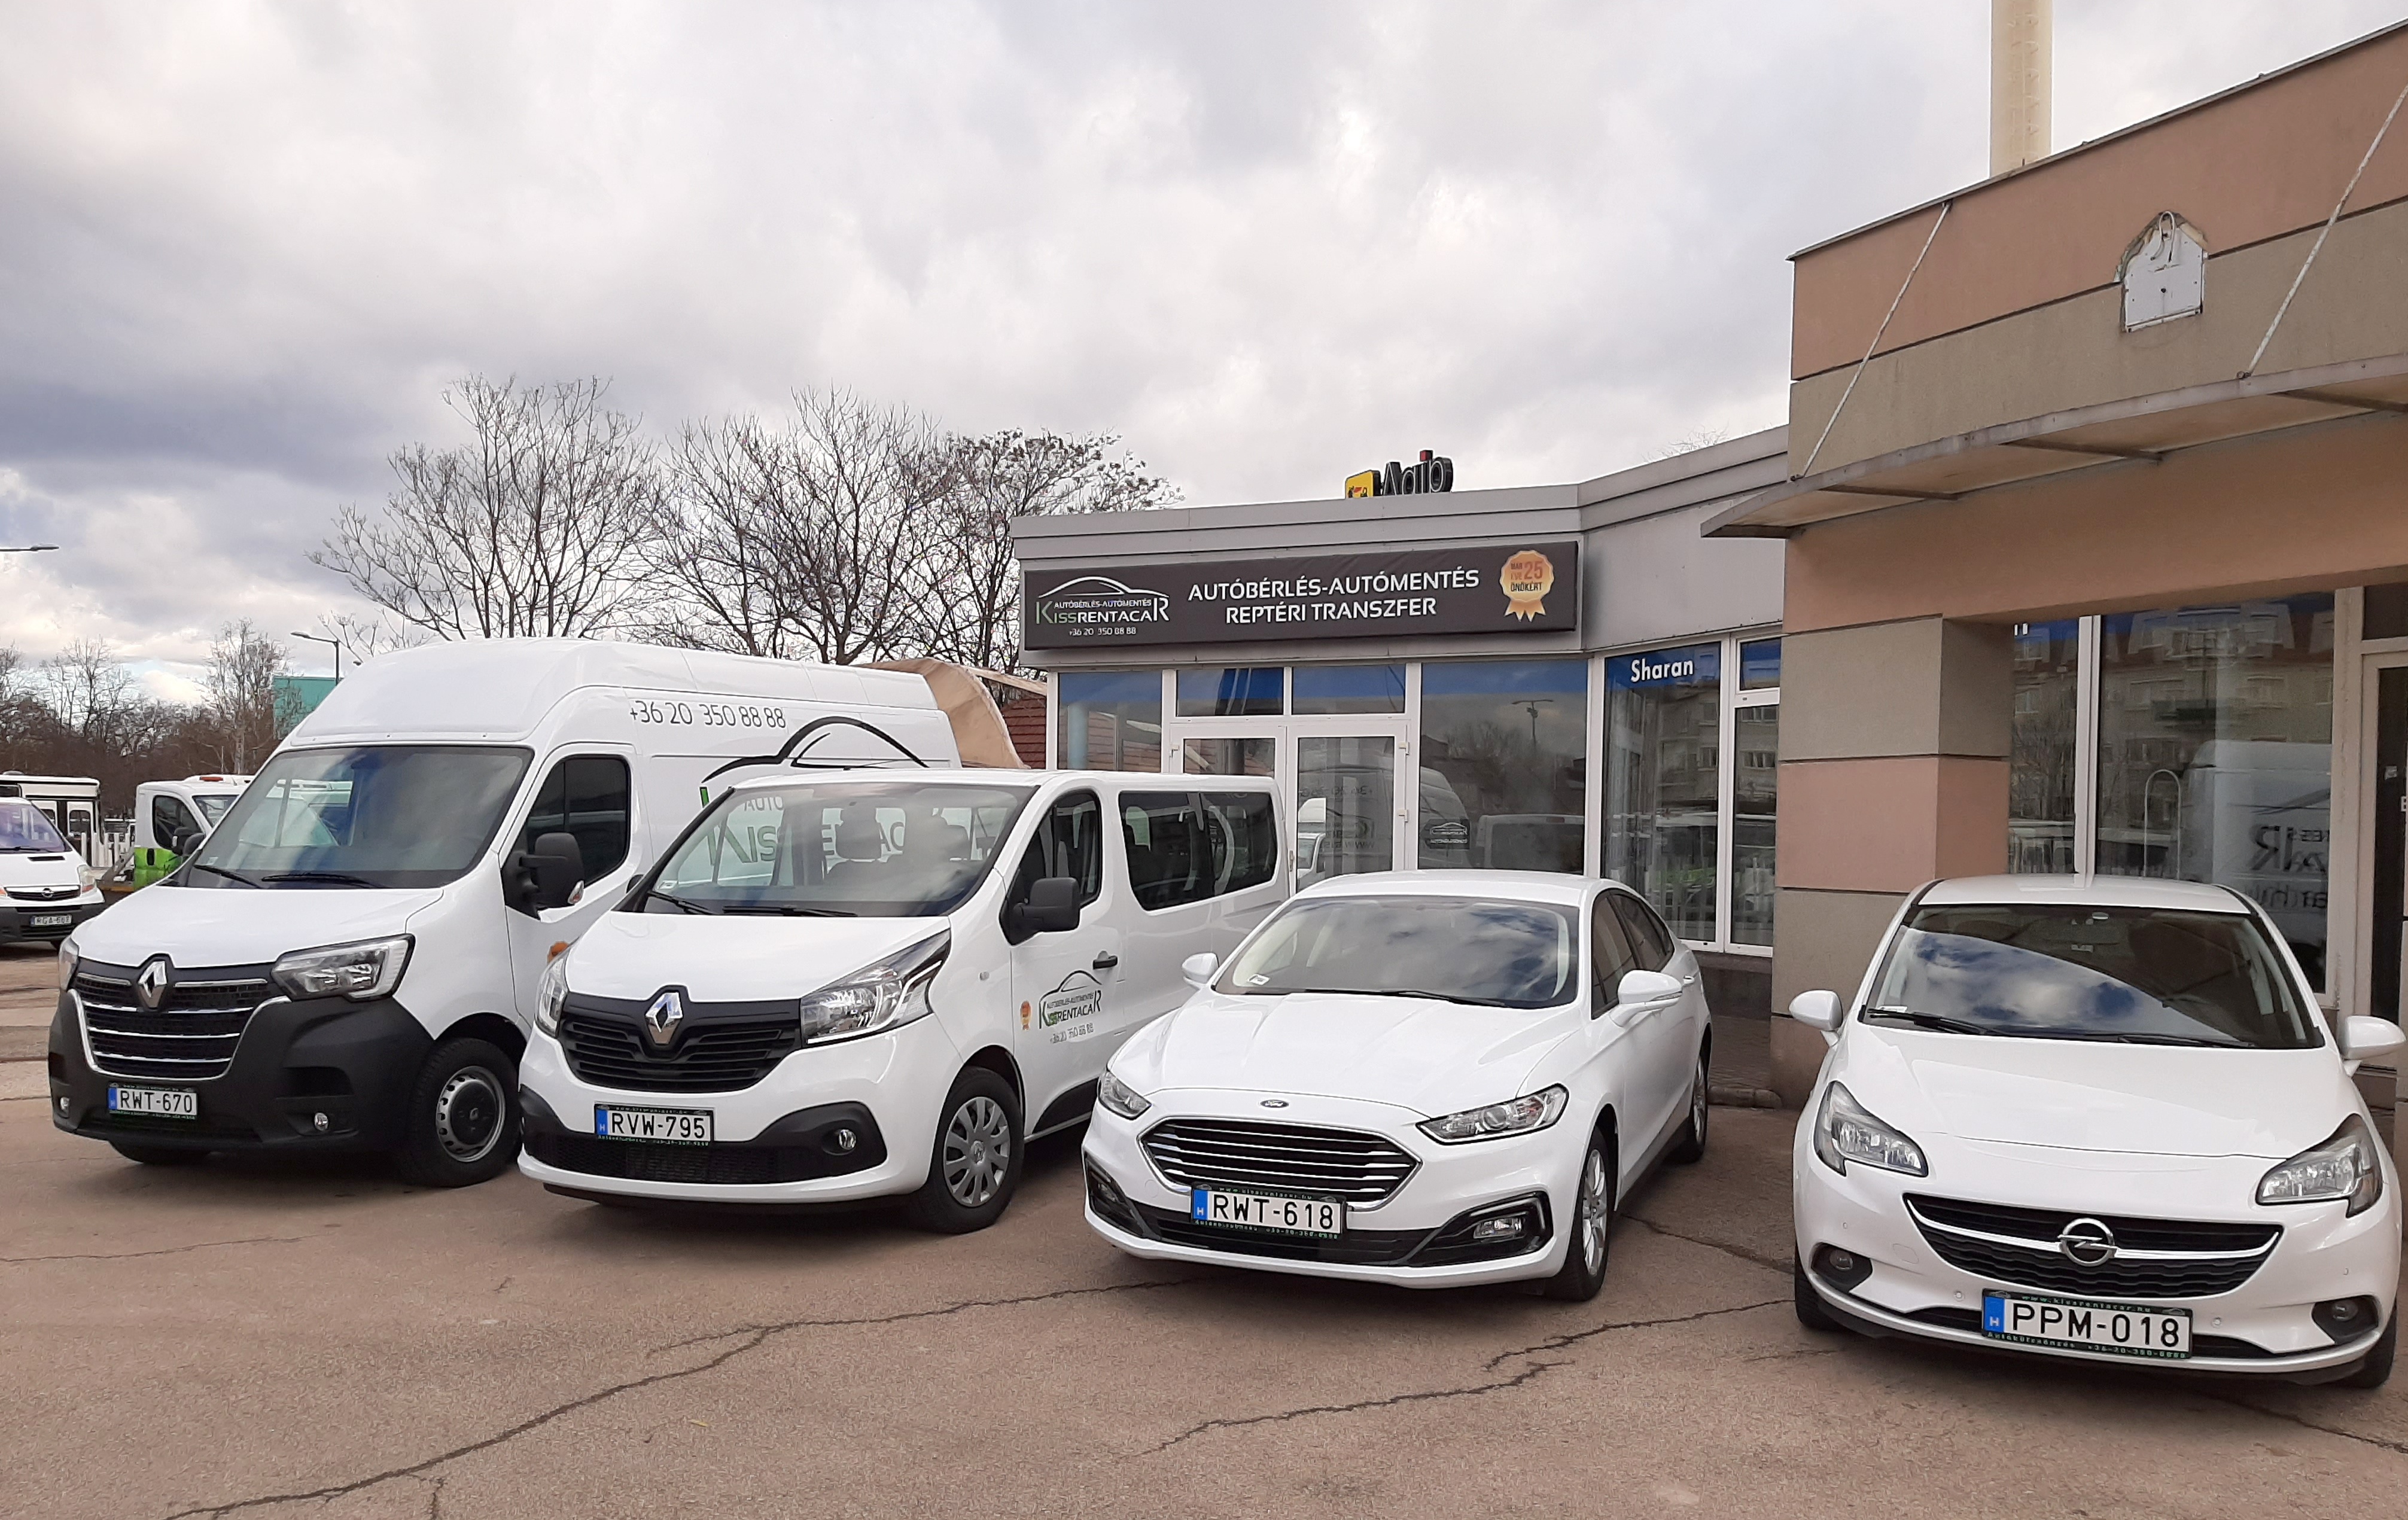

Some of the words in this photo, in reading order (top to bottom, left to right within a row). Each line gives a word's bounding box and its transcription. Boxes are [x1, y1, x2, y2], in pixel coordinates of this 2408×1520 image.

[1188, 566, 1480, 601] AUTÓBÉRLÉS-AUTÓMENTÉS
[1524, 561, 1544, 580] 25
[1226, 601, 1306, 624] REPTÉRI
[1311, 598, 1436, 621] TRANSZFER
[1630, 658, 1694, 683] Sharan
[630, 700, 663, 723] +36
[665, 702, 693, 725] 20
[699, 704, 736, 726] 350
[738, 706, 762, 727] 88
[764, 707, 786, 729] 88
[120, 1090, 193, 1113] RWT-670
[612, 1112, 705, 1139] RVW-795
[1197, 1207, 1204, 1216] H
[1214, 1194, 1334, 1230] RWT-618
[1989, 1316, 1999, 1327] H
[2013, 1303, 2179, 1348] PPM-018
